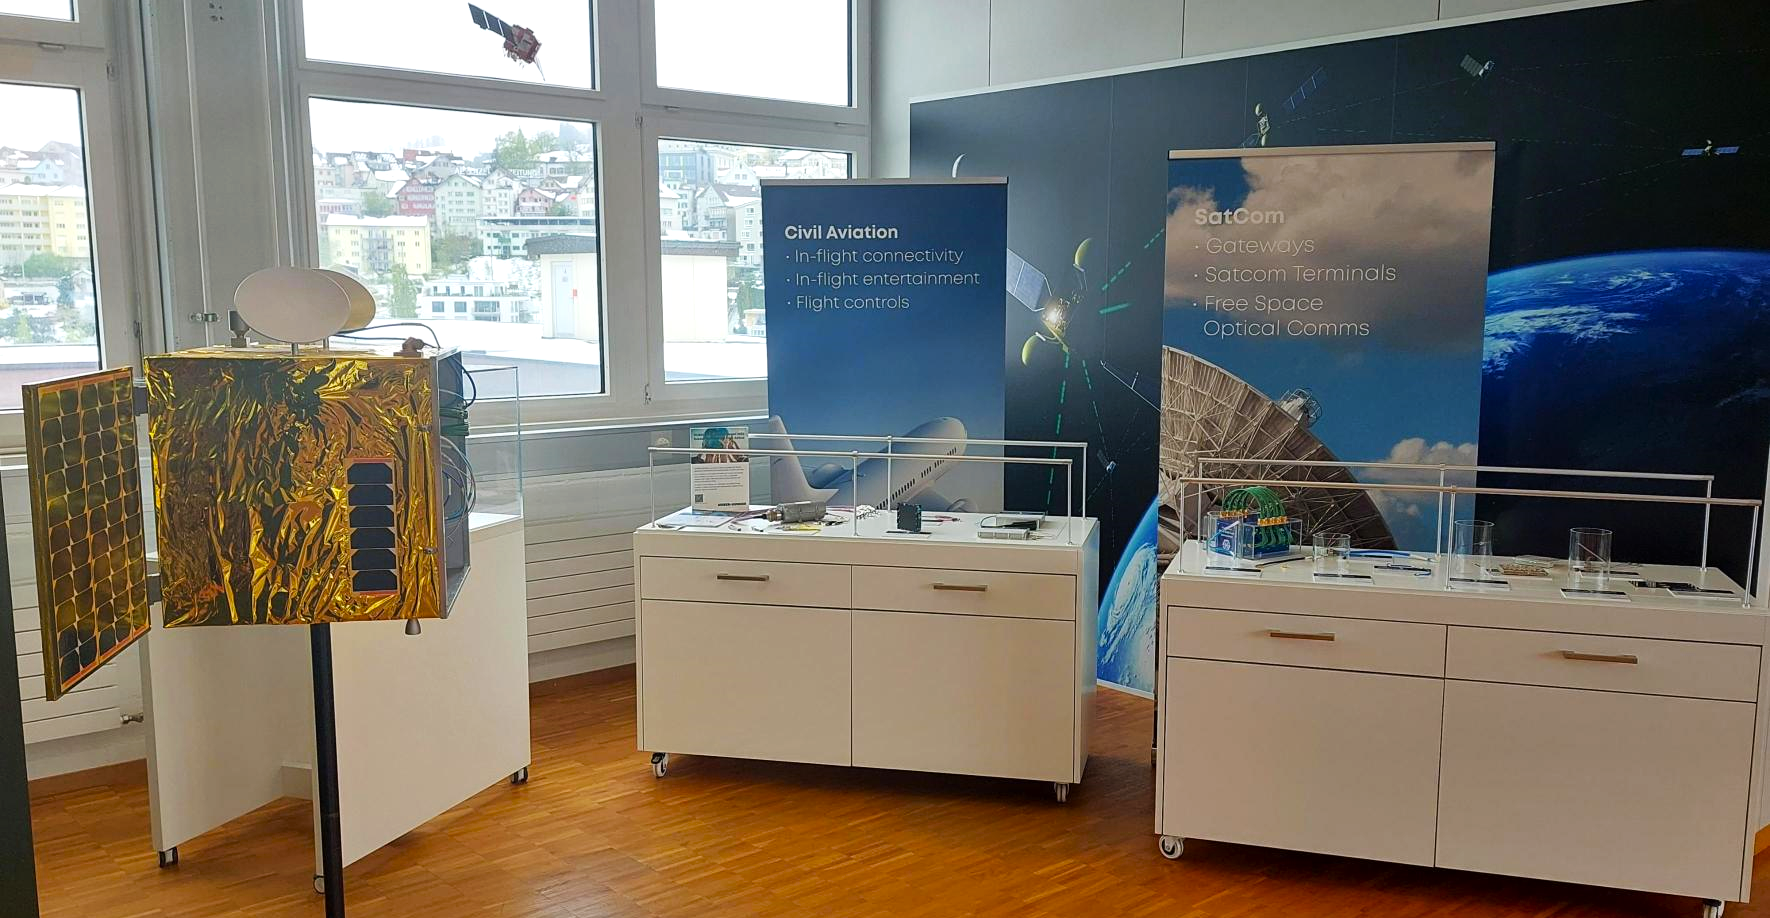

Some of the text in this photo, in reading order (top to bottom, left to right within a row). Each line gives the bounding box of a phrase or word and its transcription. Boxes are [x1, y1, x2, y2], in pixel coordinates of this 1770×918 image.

[1195, 207, 1285, 225] SatCom
[784, 225, 898, 240] Civil Aviation
[1206, 237, 1315, 257] Gateways
[795, 248, 964, 266] In-flight connectivity
[796, 272, 980, 289] In-flight entertainment
[1205, 264, 1397, 283] Satcom Terminals
[797, 296, 910, 312] Flight controls
[1205, 295, 1324, 314] Free Space
[1204, 319, 1370, 339] Optical Comms
